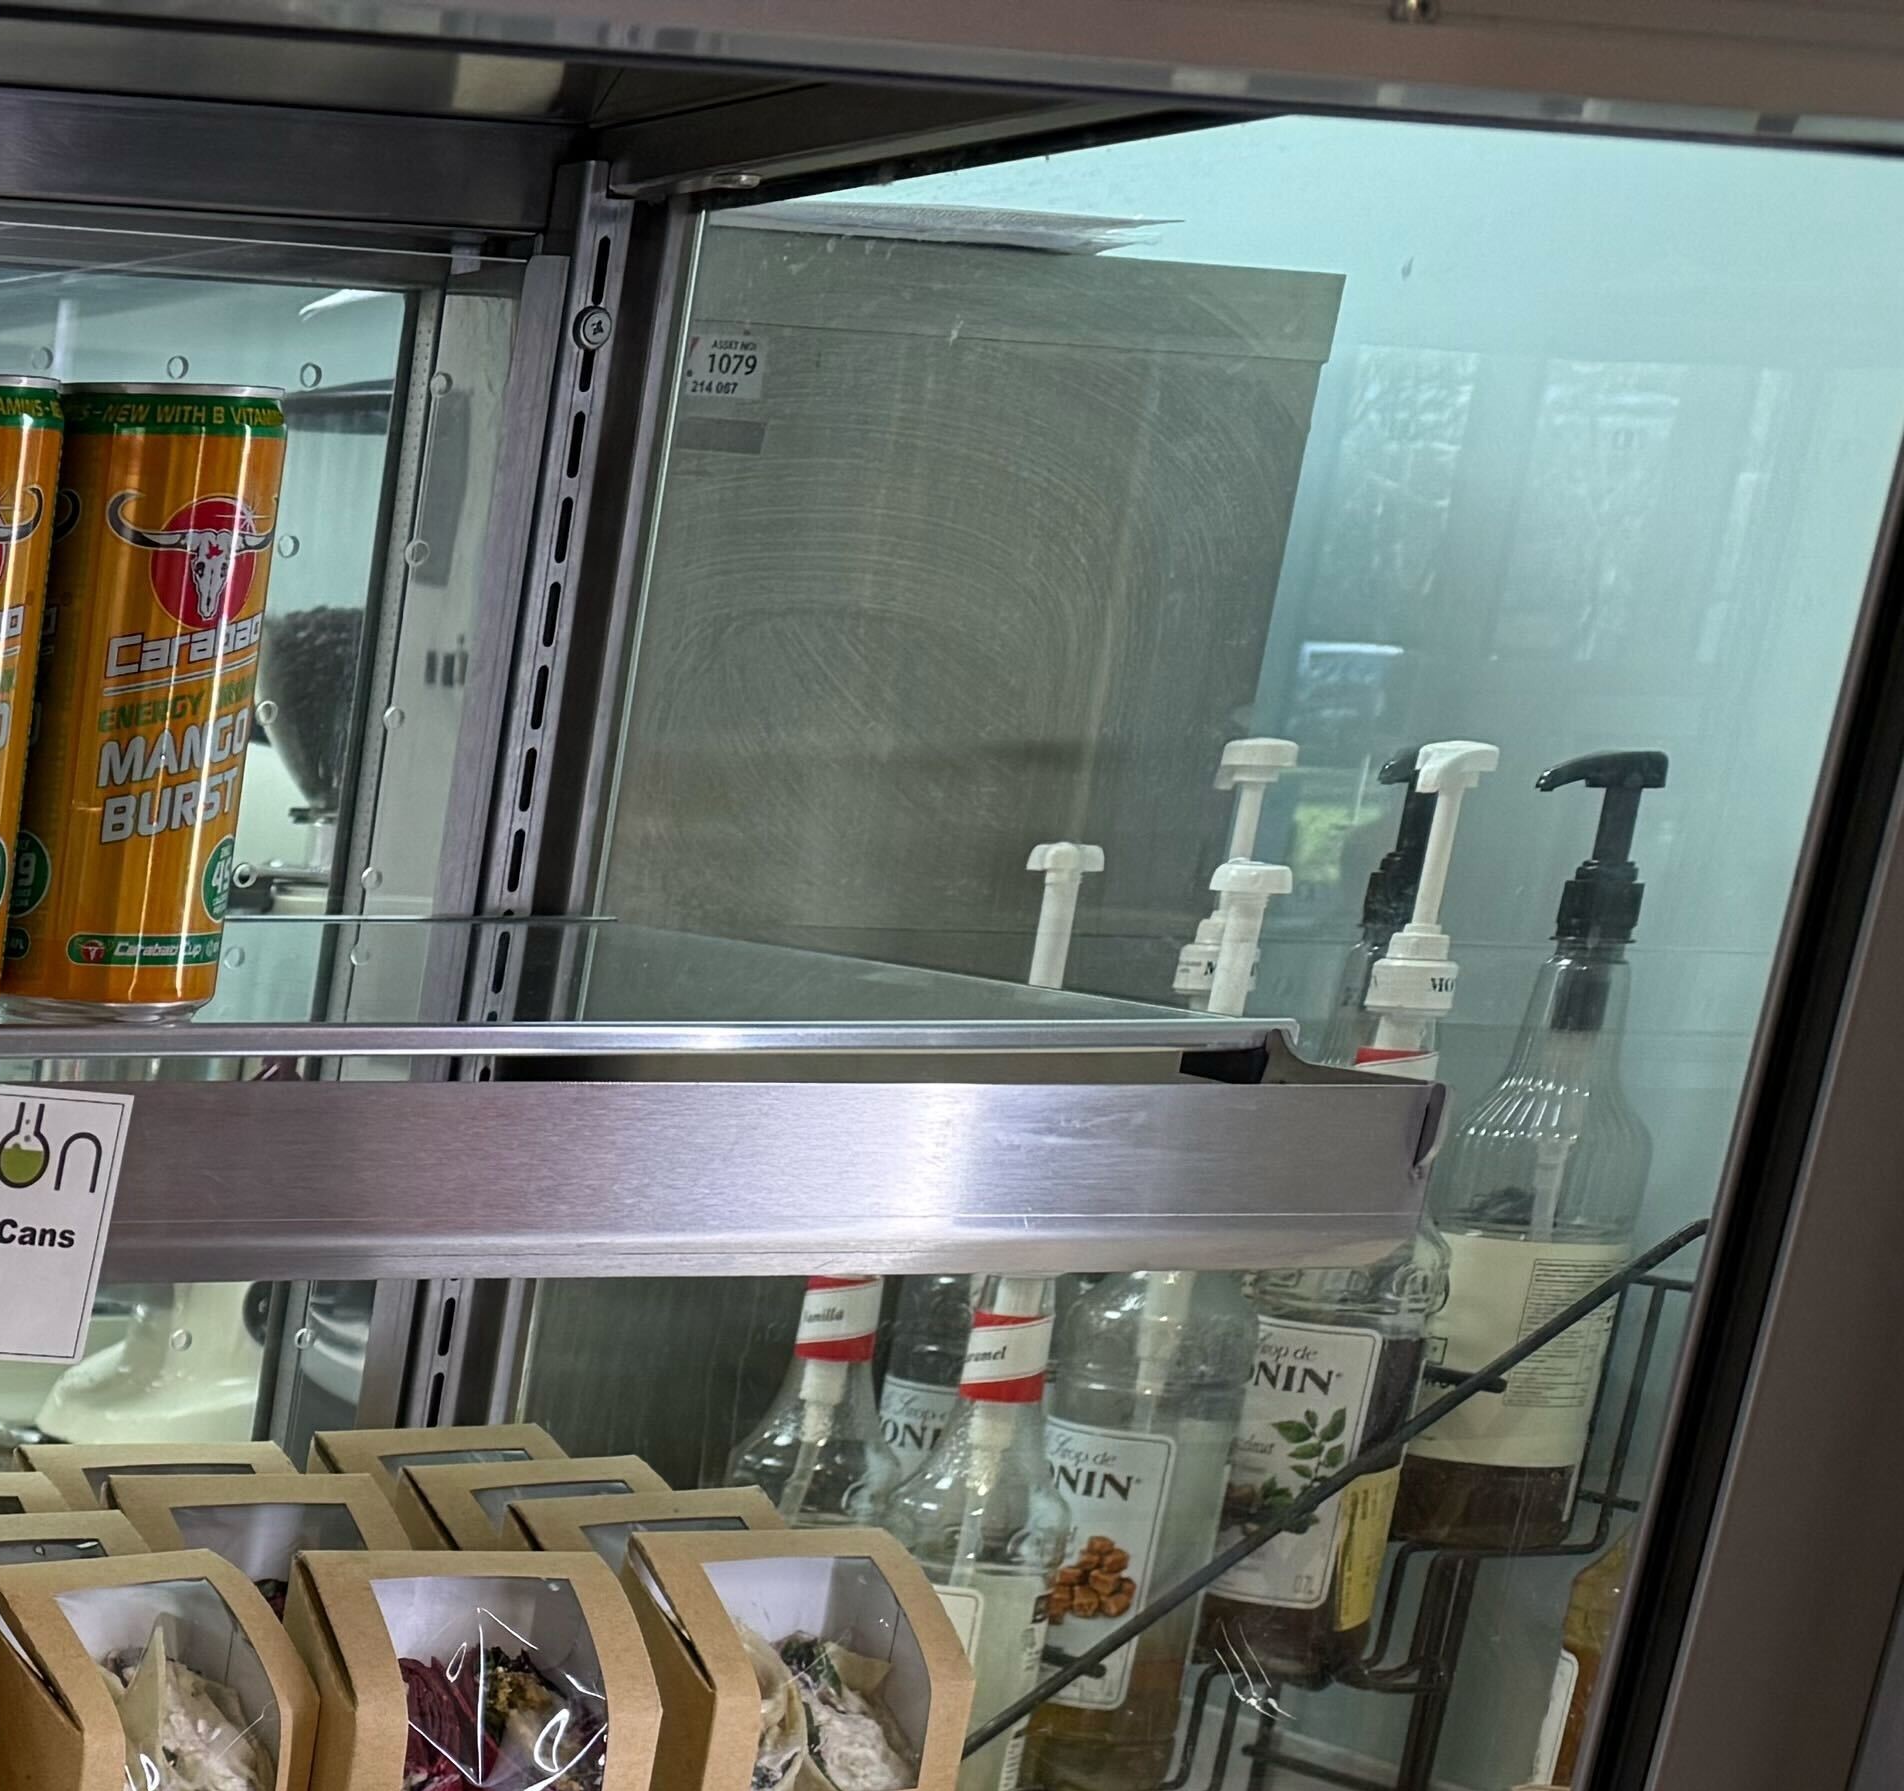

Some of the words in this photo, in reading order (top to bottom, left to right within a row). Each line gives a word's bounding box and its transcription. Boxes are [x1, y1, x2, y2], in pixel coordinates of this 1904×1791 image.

[708, 353, 757, 375] 1079
[104, 612, 264, 679] Carabao
[97, 706, 251, 789] MANGO
[100, 767, 239, 845] BURST
